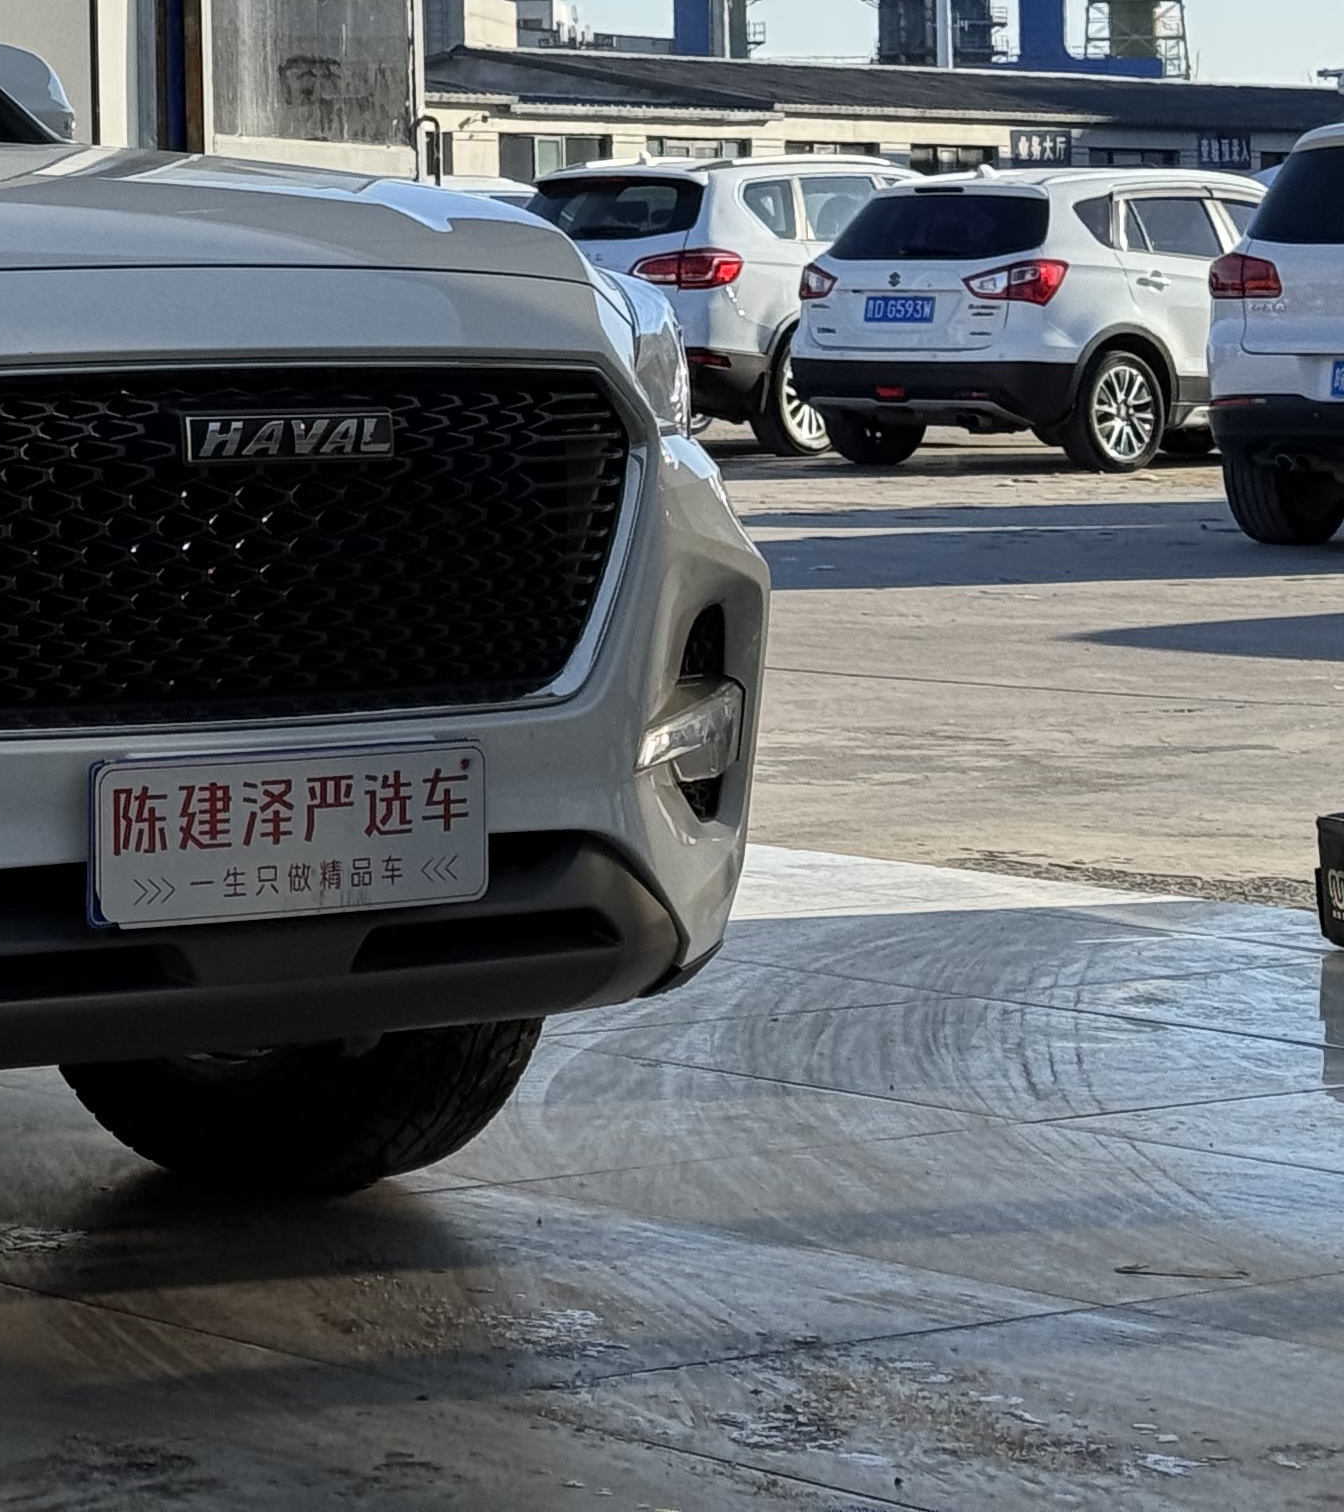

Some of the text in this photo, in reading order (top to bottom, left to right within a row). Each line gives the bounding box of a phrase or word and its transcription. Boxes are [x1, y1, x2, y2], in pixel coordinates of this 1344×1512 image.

[1018, 135, 1067, 161] 业务大厅
[198, 418, 391, 457] HAVAL
[113, 768, 469, 856] 陈建泽严选车
[189, 855, 404, 899] 一生只做精品车
